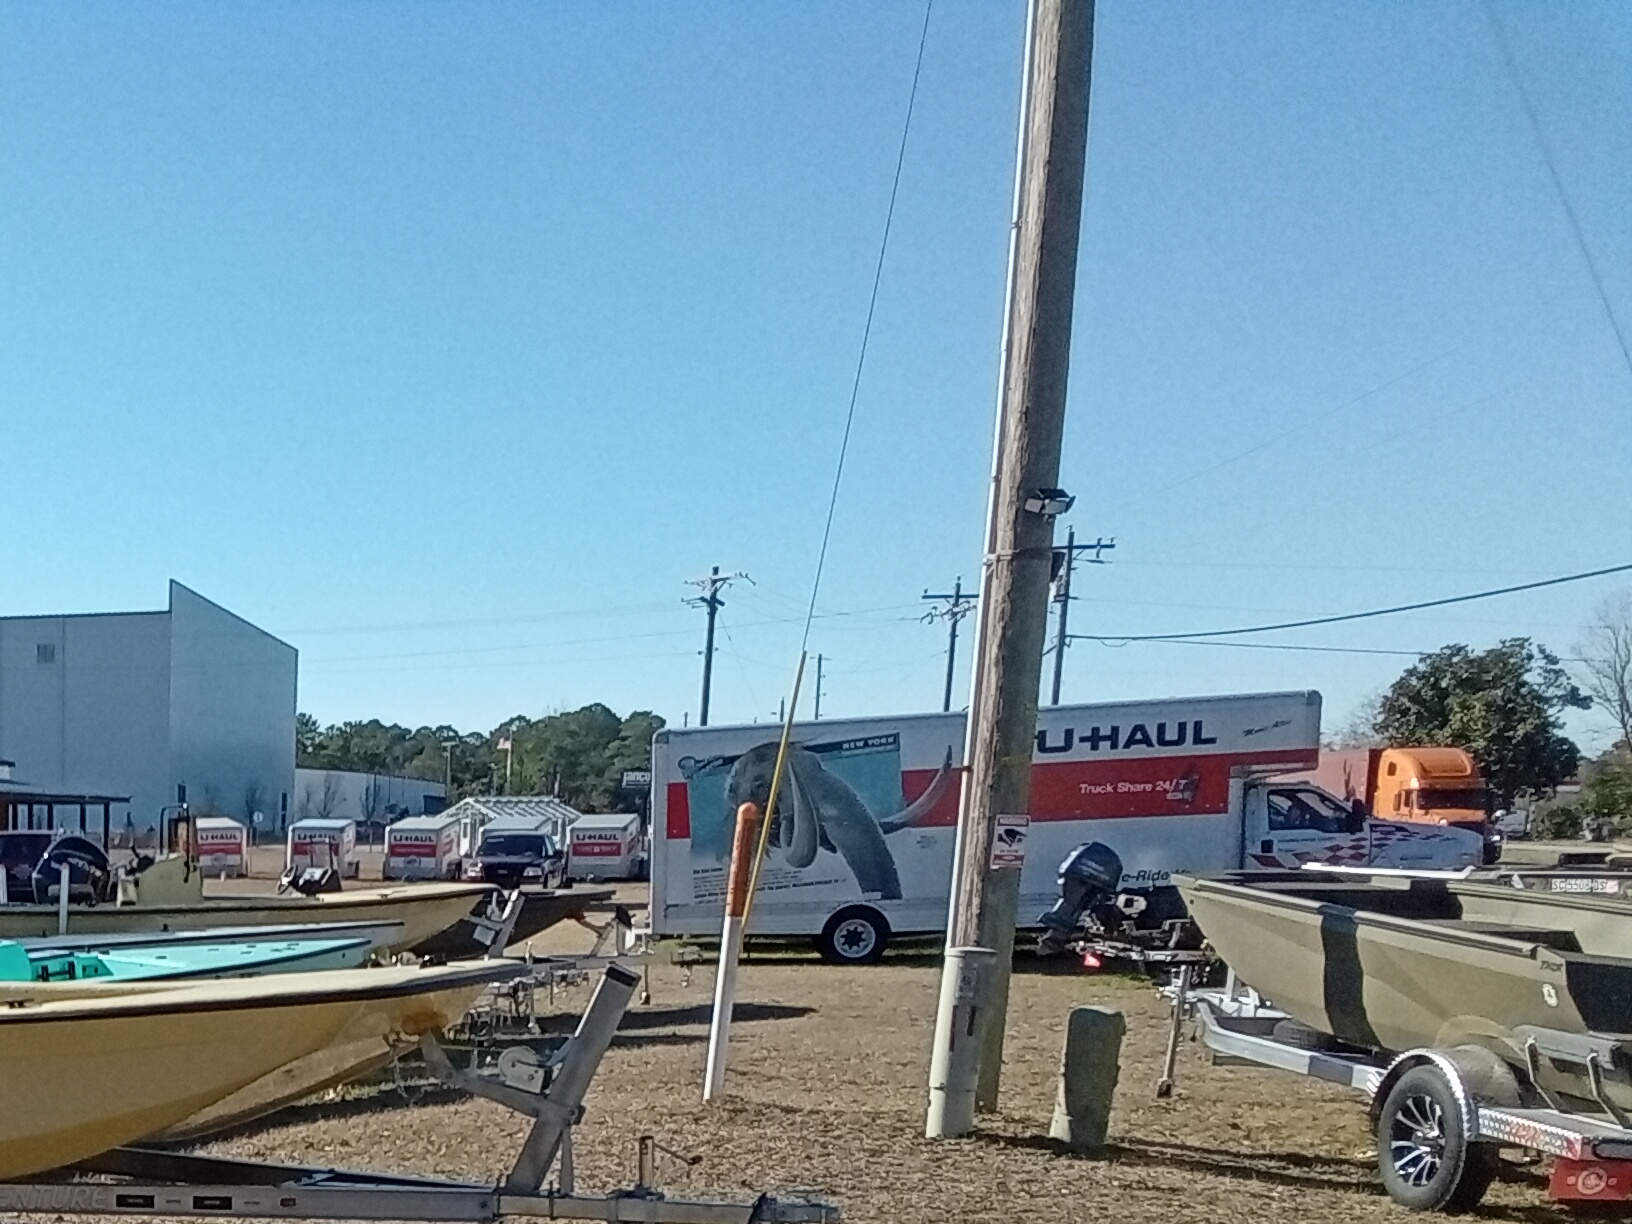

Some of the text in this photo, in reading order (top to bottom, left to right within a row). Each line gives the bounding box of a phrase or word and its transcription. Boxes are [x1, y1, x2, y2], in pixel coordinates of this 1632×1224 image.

[842, 736, 895, 750] NEW YORK
[1036, 719, 1218, 754] U-HAUL
[1079, 778, 1189, 794] Truck Share 24/7
[575, 833, 620, 842] U-HAUL
